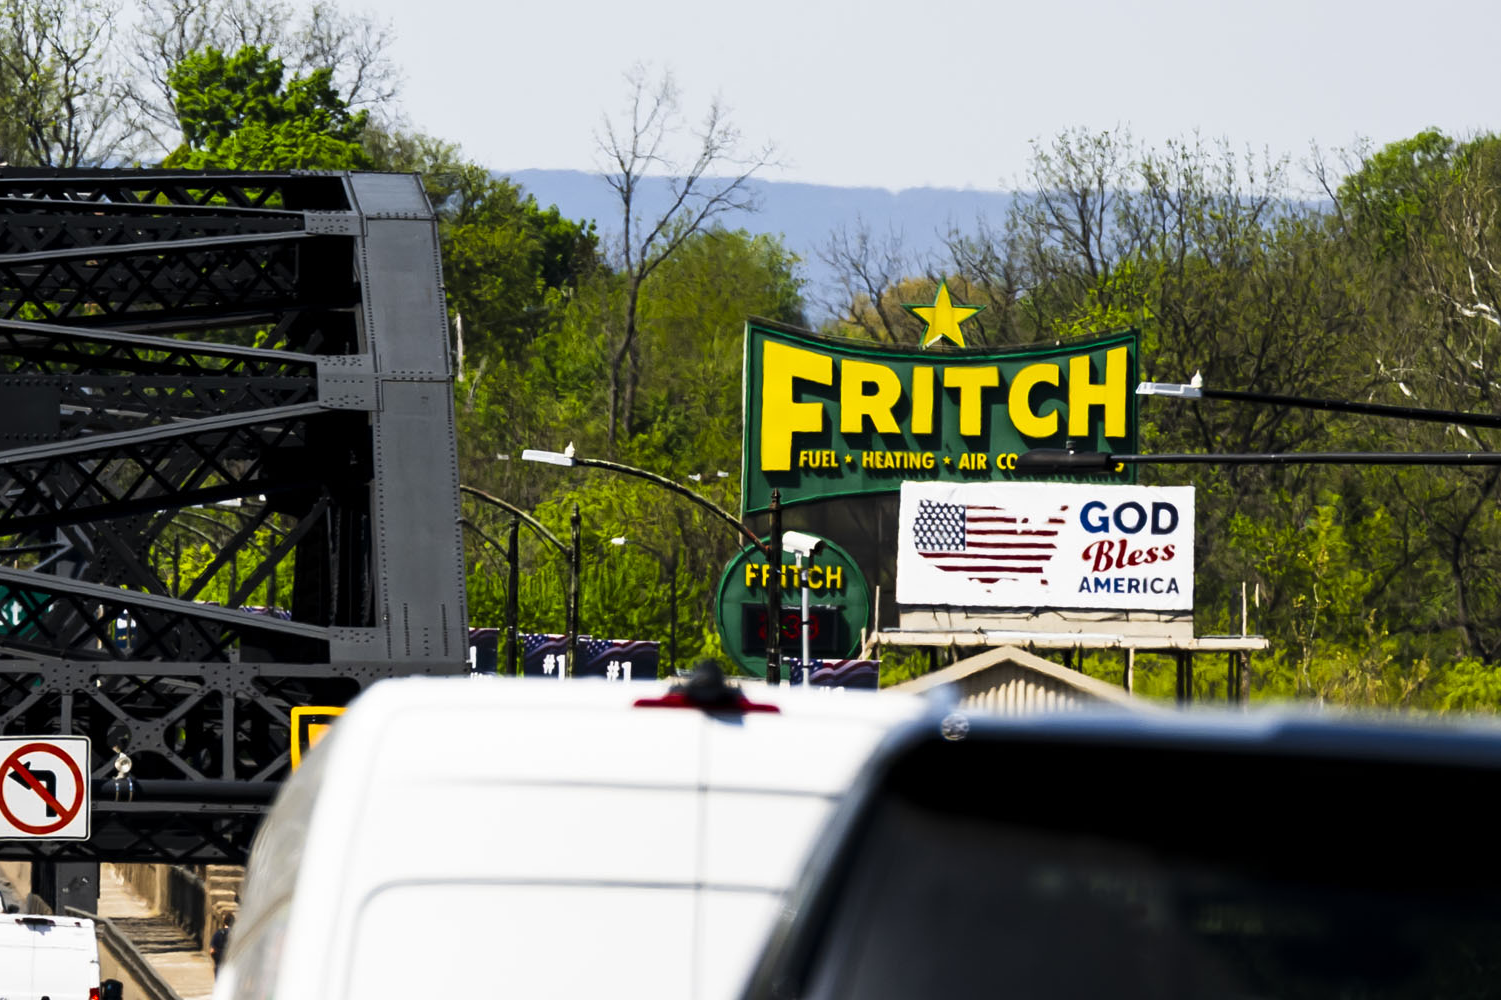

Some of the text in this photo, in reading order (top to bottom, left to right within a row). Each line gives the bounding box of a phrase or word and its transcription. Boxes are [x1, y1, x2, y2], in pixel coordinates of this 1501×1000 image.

[761, 340, 1128, 471] FRITCH
[799, 450, 839, 468] FUEL
[861, 451, 935, 470] HEATING
[958, 452, 987, 470] AIR
[1080, 500, 1179, 535] GOD
[1082, 538, 1176, 574] Bless
[1078, 576, 1180, 595] AMERICA
